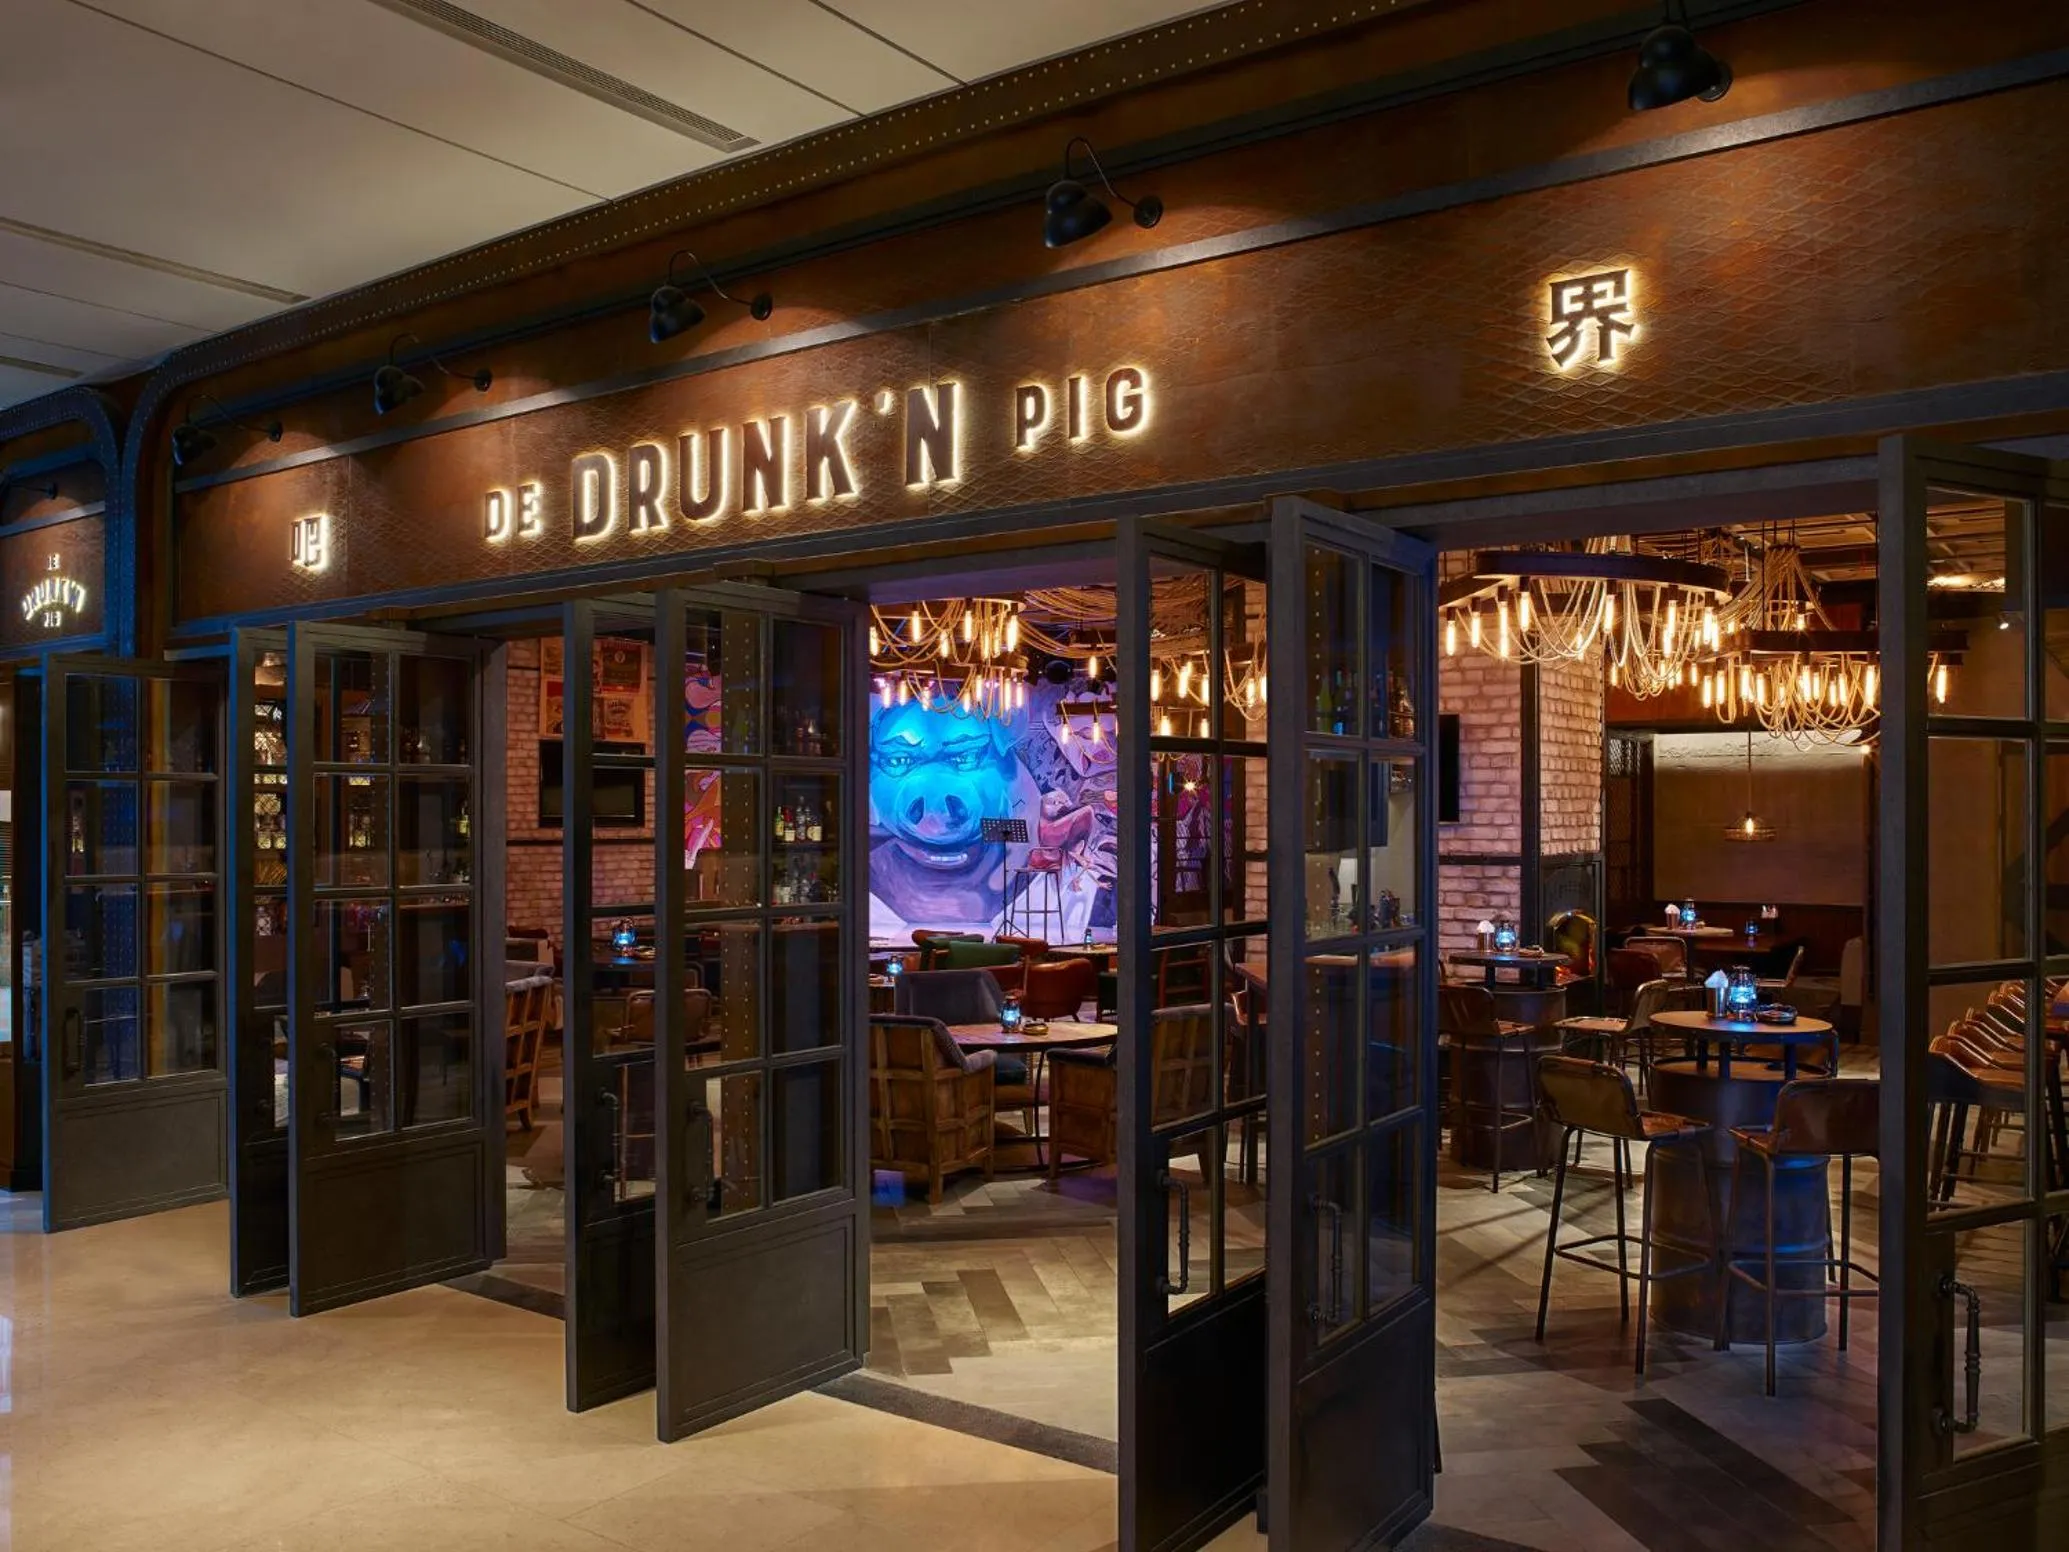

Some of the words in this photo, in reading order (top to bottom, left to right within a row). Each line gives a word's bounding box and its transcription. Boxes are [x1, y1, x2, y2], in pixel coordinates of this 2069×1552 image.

[1546, 267, 1639, 370] 界
[484, 481, 543, 541] DE
[570, 380, 962, 544] DRUNK'N
[1014, 366, 1151, 453] PIG
